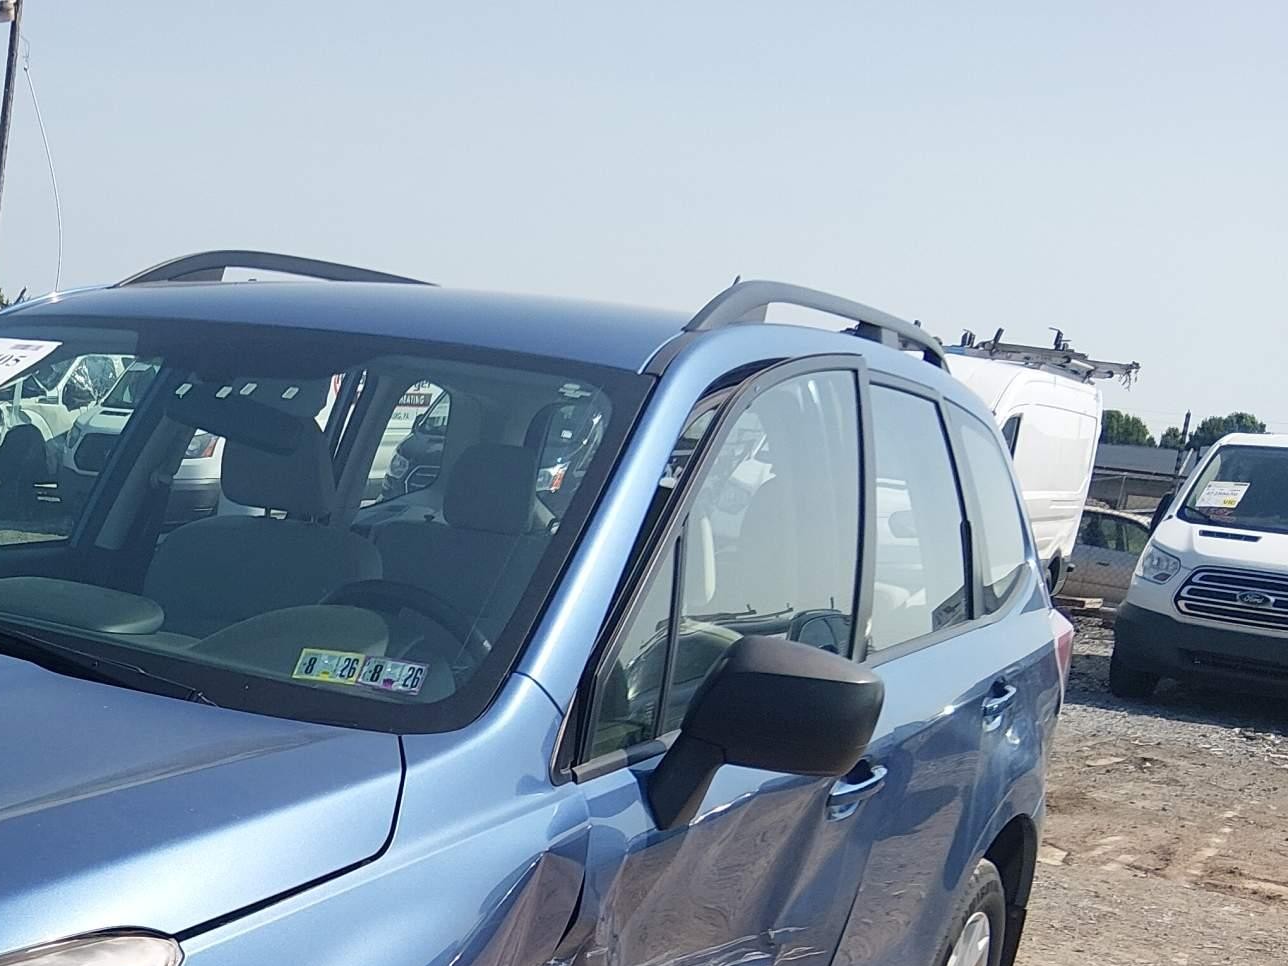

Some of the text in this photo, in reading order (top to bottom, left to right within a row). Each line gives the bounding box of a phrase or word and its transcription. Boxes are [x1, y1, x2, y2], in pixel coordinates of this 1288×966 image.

[1243, 594, 1265, 604] Ford
[304, 657, 359, 679] 8 26
[369, 664, 424, 688] 8 26
